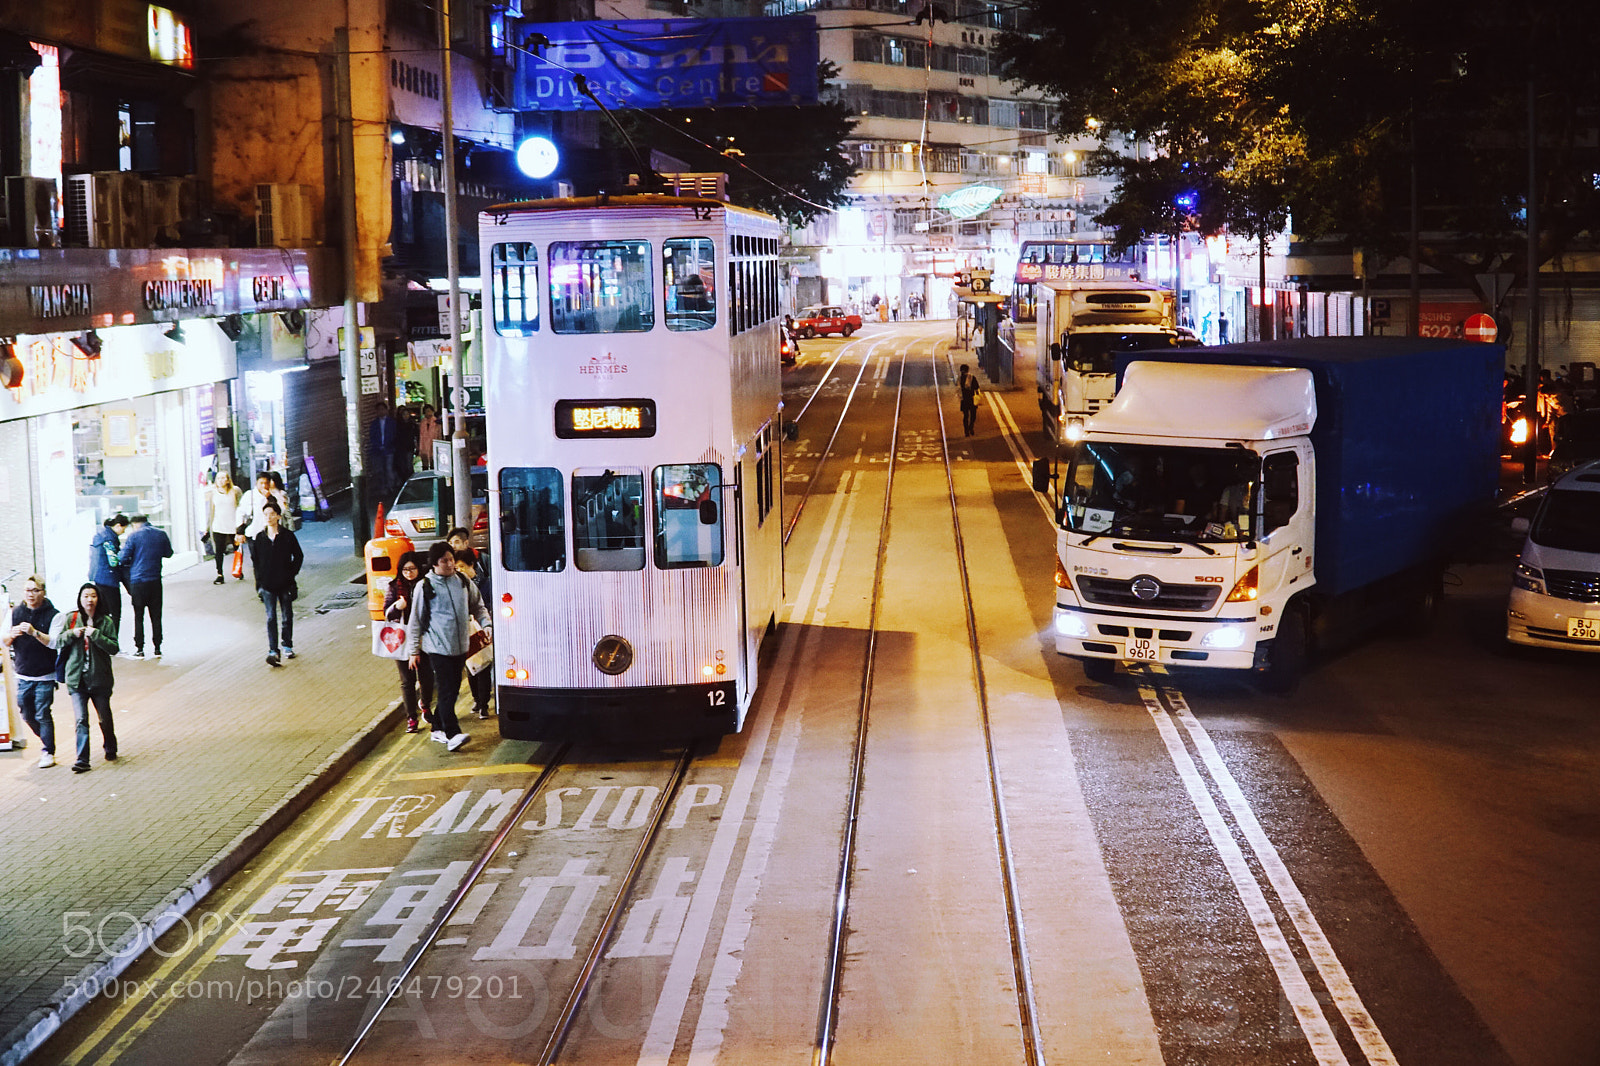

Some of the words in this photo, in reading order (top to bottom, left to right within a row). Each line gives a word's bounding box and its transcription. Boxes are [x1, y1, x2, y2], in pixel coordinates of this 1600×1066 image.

[537, 74, 632, 98] Divers
[656, 71, 760, 97] Centre
[494, 213, 508, 225] 12
[693, 206, 712, 220] 12
[143, 278, 216, 310] COMMERCIAL
[573, 407, 641, 430] 堅尼地城
[1194, 575, 1224, 583] 500
[1577, 619, 1593, 629] BJ
[1572, 628, 1596, 638] 2910
[1135, 639, 1150, 650] UD
[1129, 648, 1156, 660] 9612
[707, 690, 726, 706] 12
[331, 788, 521, 841] TRAM
[523, 783, 723, 831] STOP
